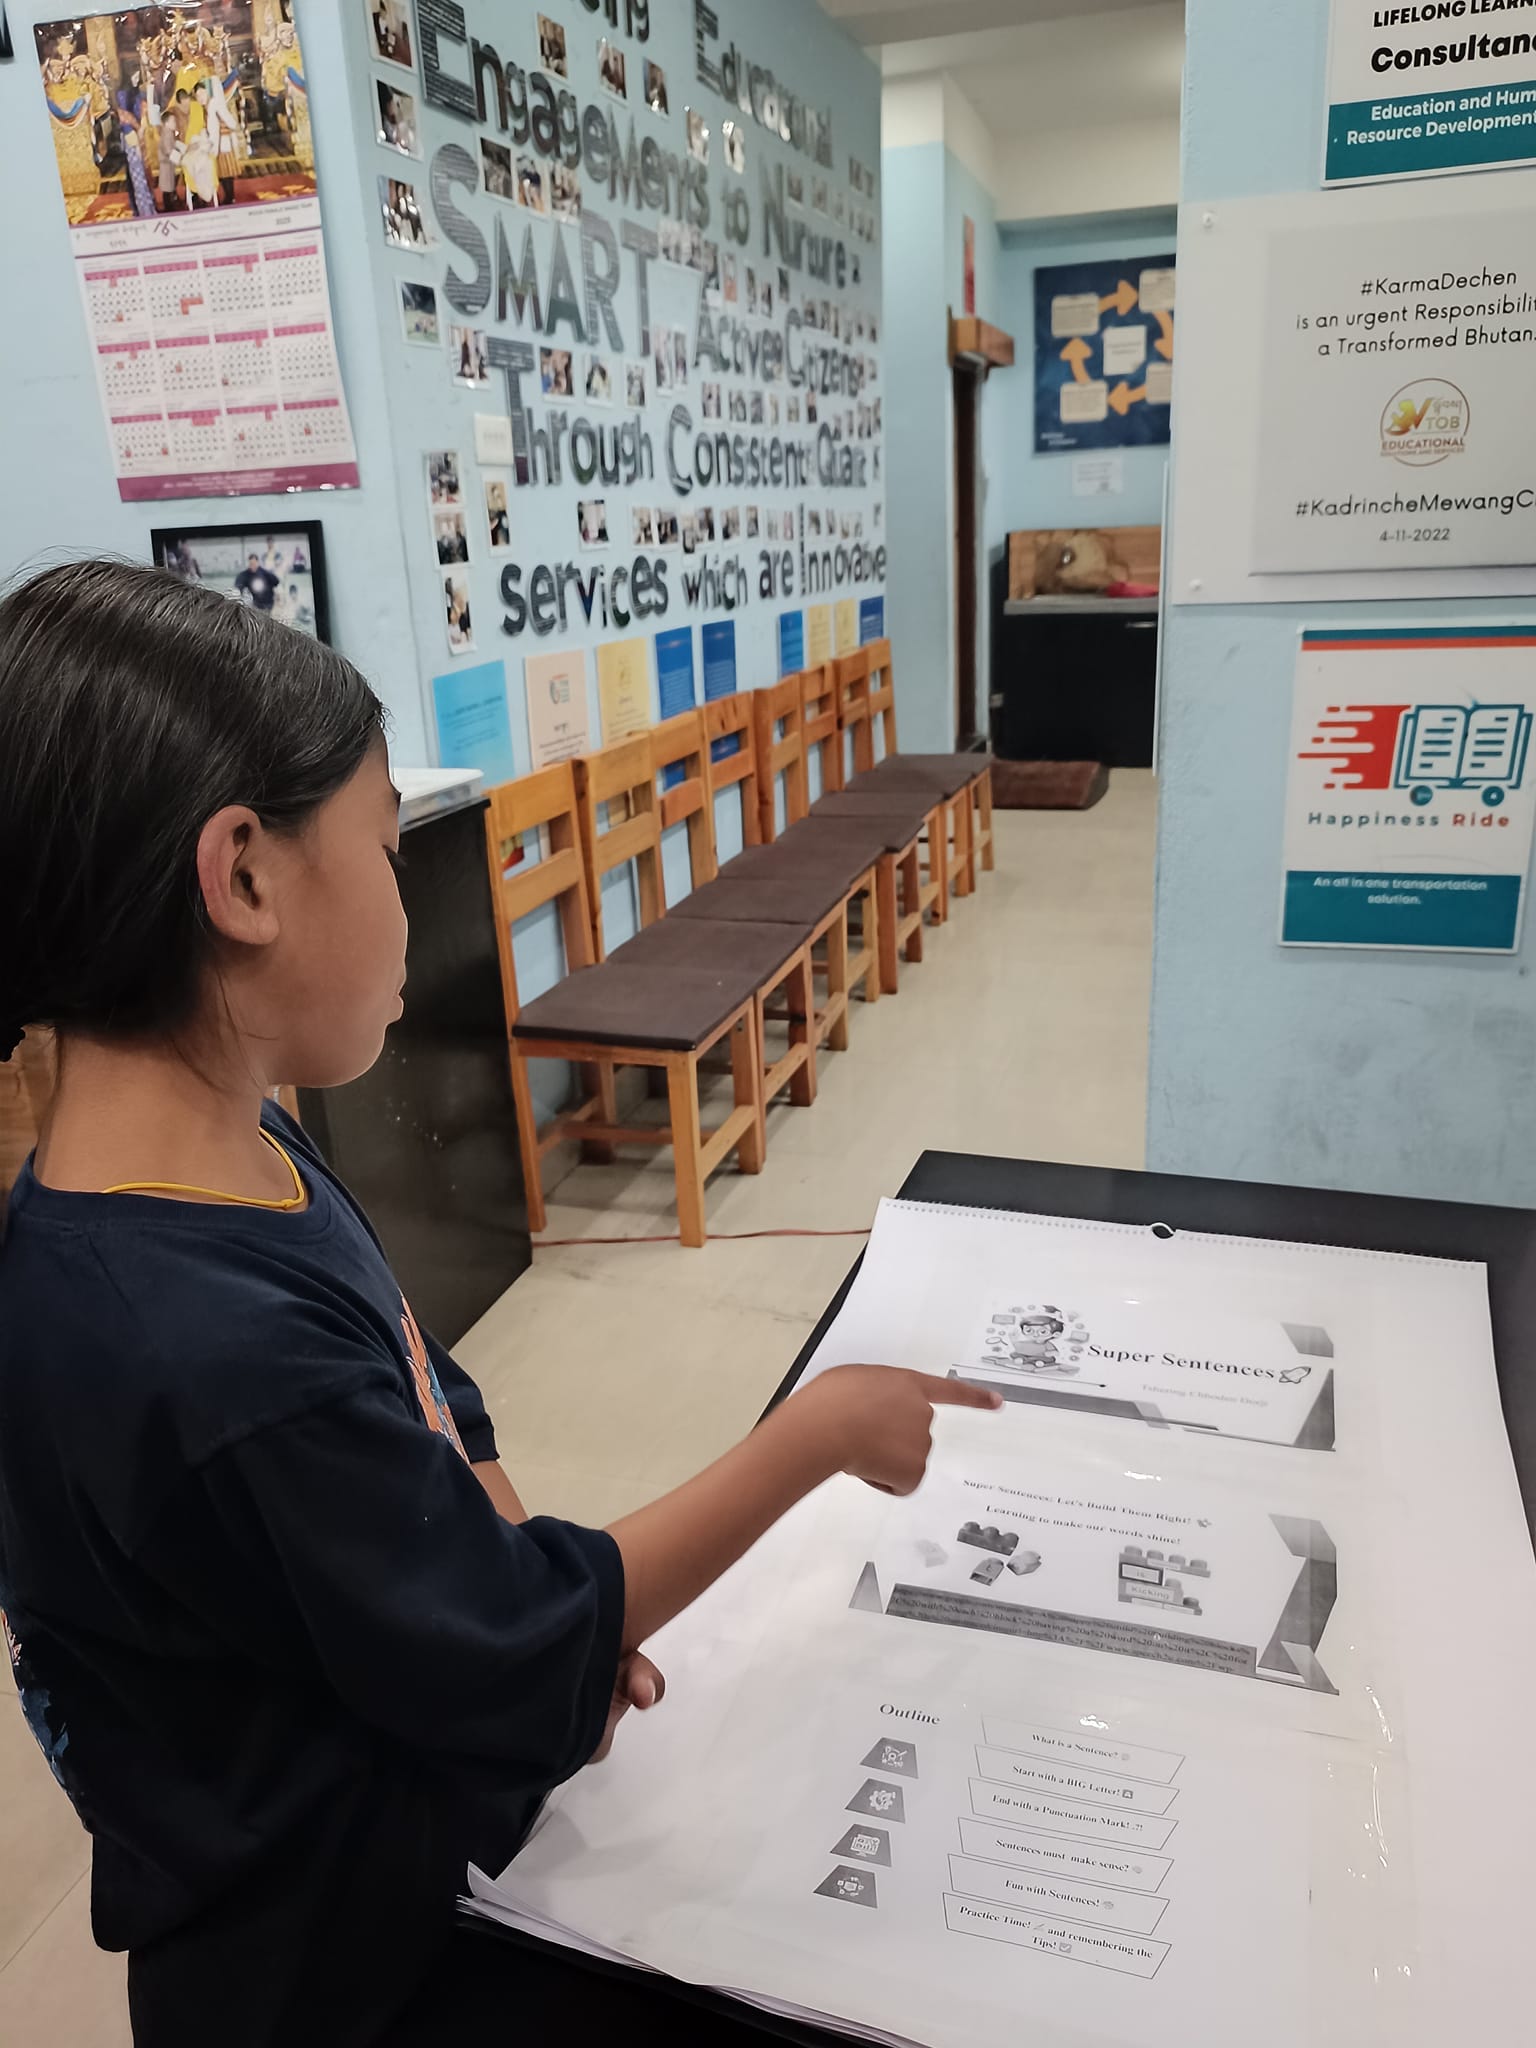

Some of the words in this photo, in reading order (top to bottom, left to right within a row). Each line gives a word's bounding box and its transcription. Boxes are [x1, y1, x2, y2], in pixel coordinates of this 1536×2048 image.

[1373, 0, 1467, 27] LIFELONG
[1371, 33, 1536, 73] Consultan
[1371, 97, 1456, 121] Education
[1459, 91, 1492, 110] and
[1346, 126, 1422, 145] Resource
[1426, 110, 1536, 139] Development
[723, 178, 751, 247] to
[430, 143, 659, 357] SMART
[1361, 266, 1517, 296] #KarmaDechen
[1296, 314, 1309, 330] is
[1315, 314, 1339, 329] an
[1346, 305, 1409, 330] urgent
[1317, 343, 1331, 356] a
[1338, 327, 1458, 355] Transformed
[486, 336, 655, 487] Through
[1425, 415, 1461, 431] TOB
[1381, 438, 1465, 451] EDUCATIONAL
[1296, 489, 1536, 517] #KadrincheMewangC
[1379, 528, 1450, 542] 4-11-2022
[500, 555, 669, 638] services
[681, 554, 749, 611] which
[759, 548, 794, 599] are
[1308, 811, 1439, 828] Happiness
[1452, 813, 1511, 828] Ride
[1313, 876, 1330, 888] An
[1333, 876, 1349, 889] all
[1392, 877, 1489, 892] transportation
[1366, 893, 1422, 905] solution.
[1087, 1344, 1154, 1365] Super
[1162, 1352, 1275, 1379] Sentences
[963, 1479, 995, 1494] Super
[1087, 1500, 1117, 1512] Build
[1121, 1505, 1153, 1518] Them
[1155, 1511, 1191, 1525] Right!
[985, 1505, 1037, 1524] Learning
[1038, 1513, 1050, 1523] to
[1053, 1516, 1083, 1530] make
[1085, 1522, 1106, 1533] our
[1108, 1525, 1144, 1539] words
[1146, 1530, 1180, 1544] shine!
[879, 1703, 941, 1726] Outline
[1031, 1734, 1056, 1746] What
[1012, 1765, 1037, 1777] Start
[1038, 1771, 1056, 1781] with
[1067, 1778, 1086, 1789] BIG
[1089, 1782, 1120, 1798] Letter!
[992, 1794, 1010, 1806] End
[1011, 1800, 1031, 1812] with
[1042, 1805, 1099, 1824] Punctuation
[1100, 1816, 1130, 1830] Mark!
[995, 1839, 1041, 1856] Sentences
[1043, 1849, 1066, 1860] must
[1071, 1854, 1097, 1868] make
[1099, 1859, 1129, 1872] sense?
[1005, 1879, 1023, 1892] Fun
[1025, 1883, 1048, 1897] with
[1049, 1888, 1100, 1908] Sentences!
[959, 1905, 1000, 1922] Practice
[1002, 1914, 1031, 1929] Time!
[1048, 1926, 1067, 1937] and
[1068, 1931, 1134, 1956] remembering
[1136, 1947, 1153, 1958] the
[1031, 1935, 1057, 1951] Tips!
